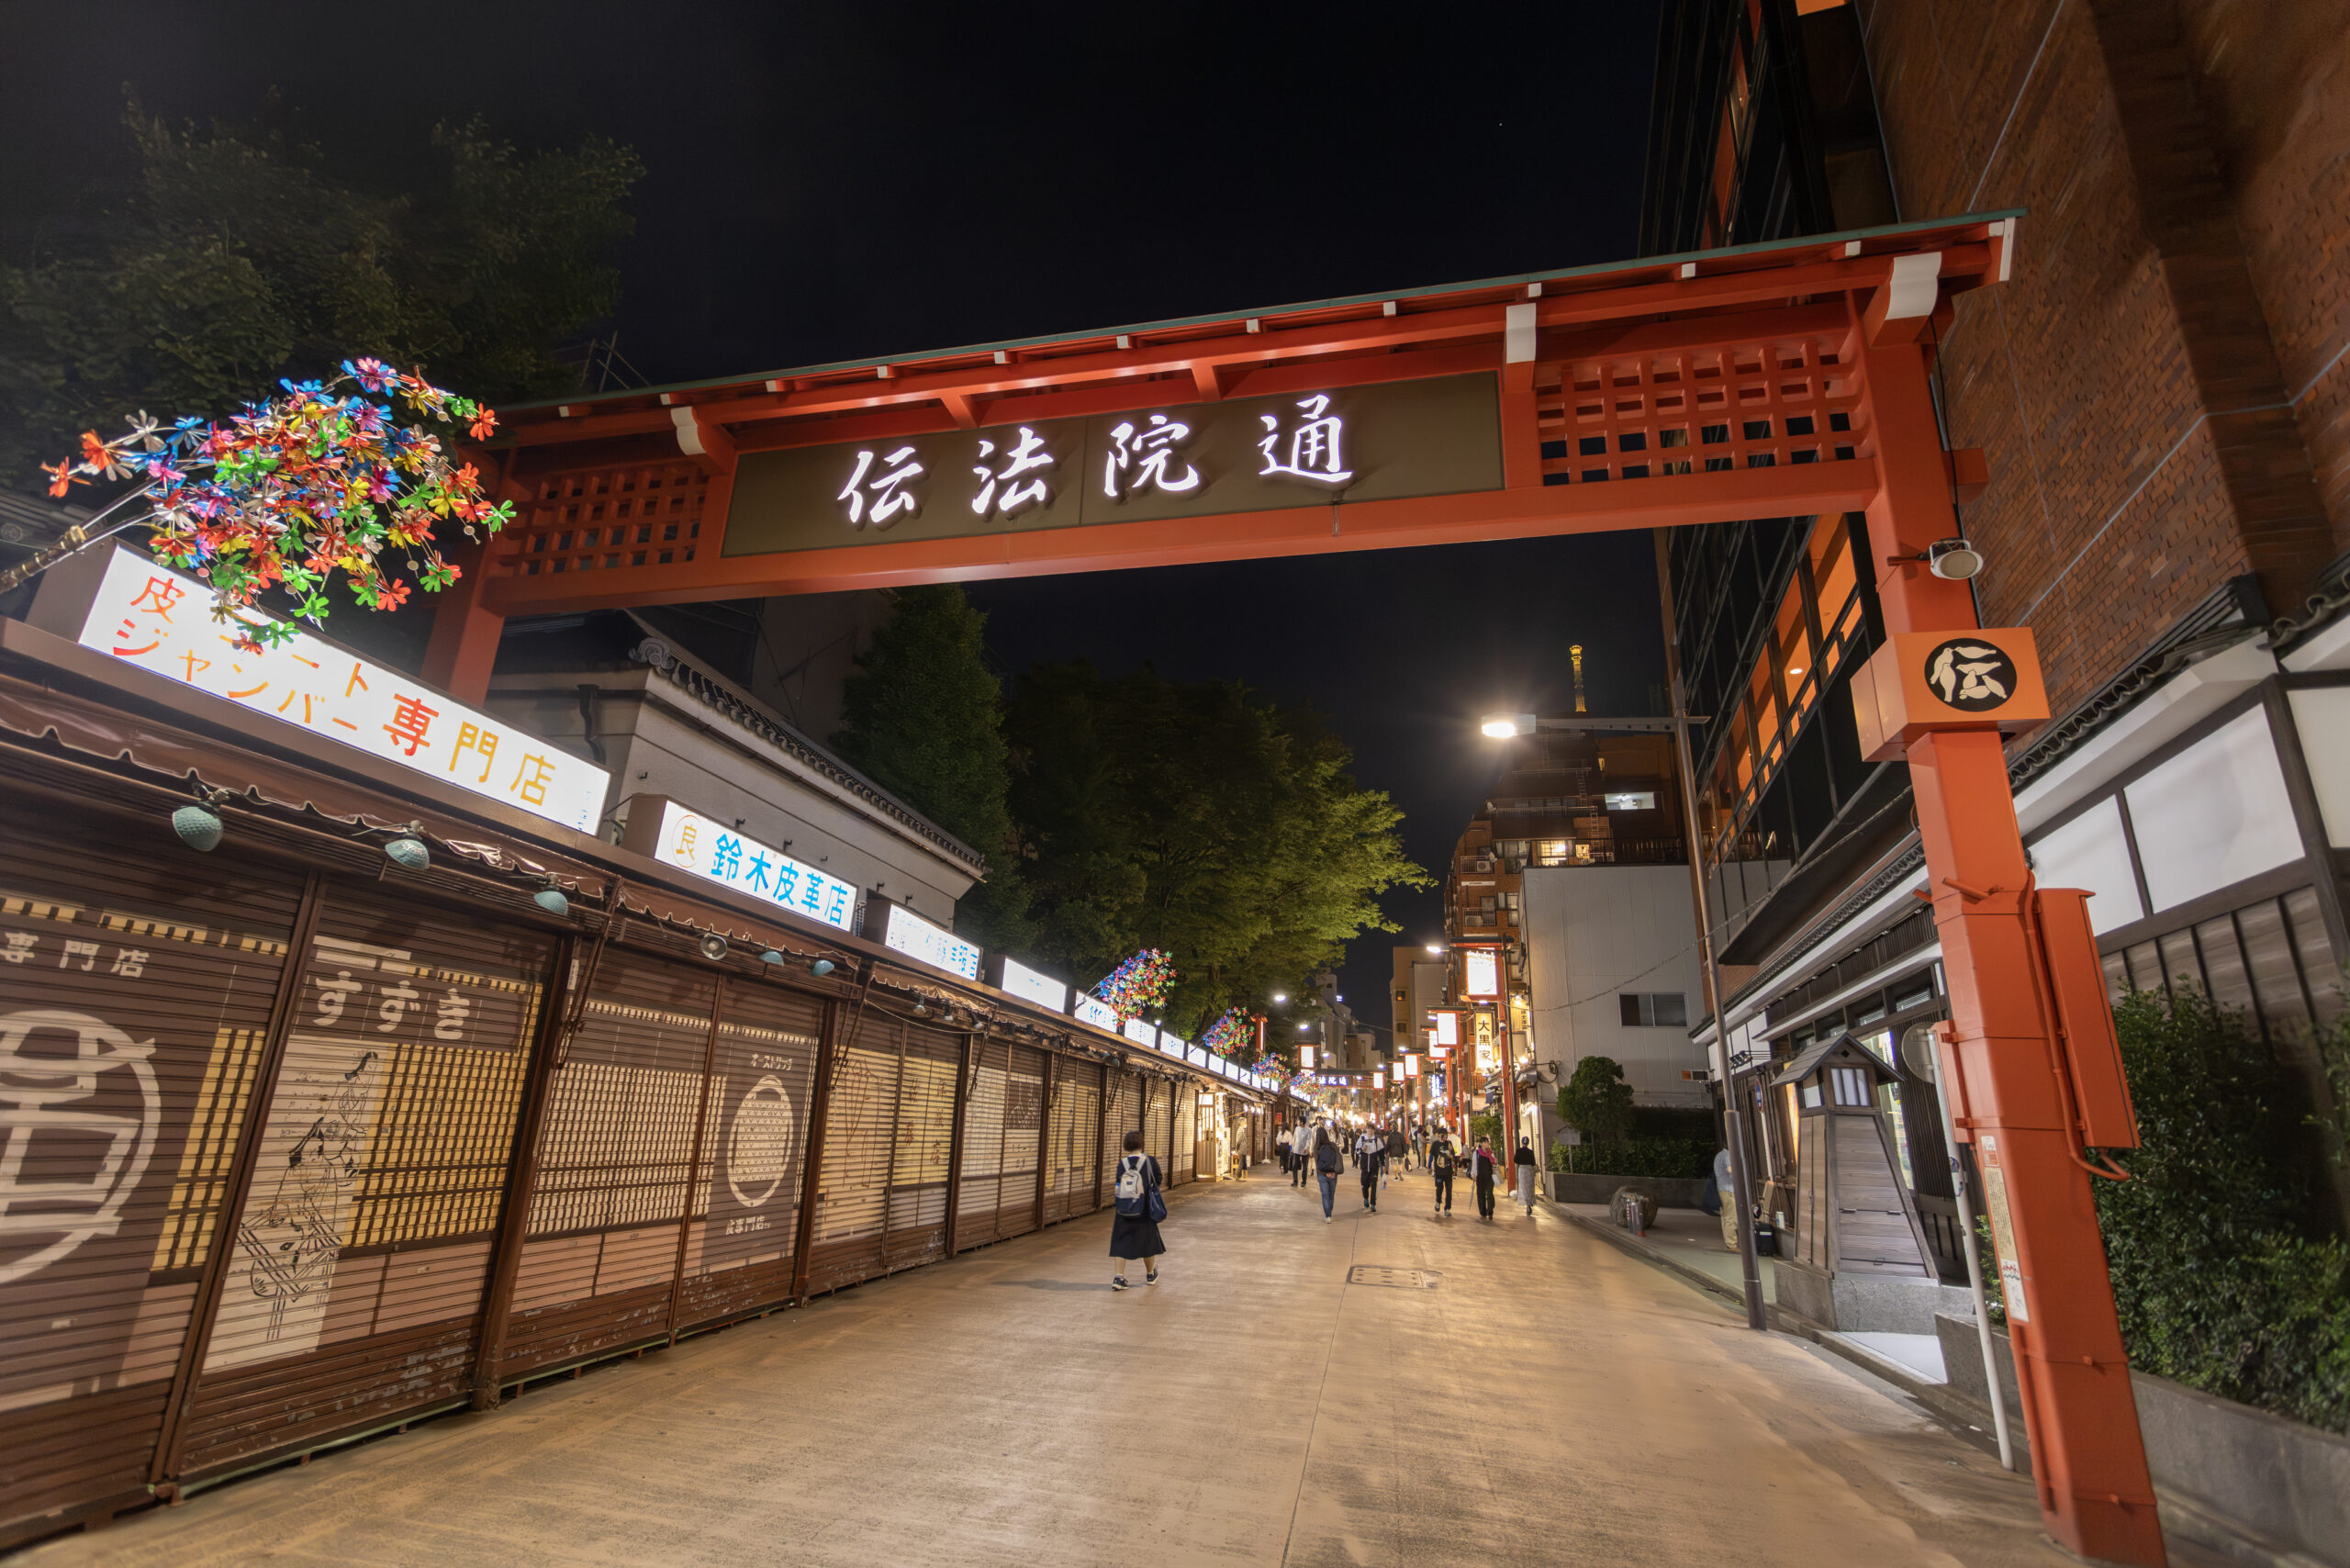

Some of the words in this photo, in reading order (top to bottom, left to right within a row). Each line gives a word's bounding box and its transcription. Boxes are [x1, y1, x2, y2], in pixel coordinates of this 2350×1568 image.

[837, 394, 1353, 523] 伝法院通
[113, 619, 357, 731] ジャンバー
[383, 693, 555, 806] 専門店
[676, 823, 699, 861] 良
[711, 833, 848, 925] 鈴木皮革店
[0, 932, 150, 978] 専門店
[312, 971, 471, 1040] すずき
[1478, 1020, 1492, 1061] 大黒家
